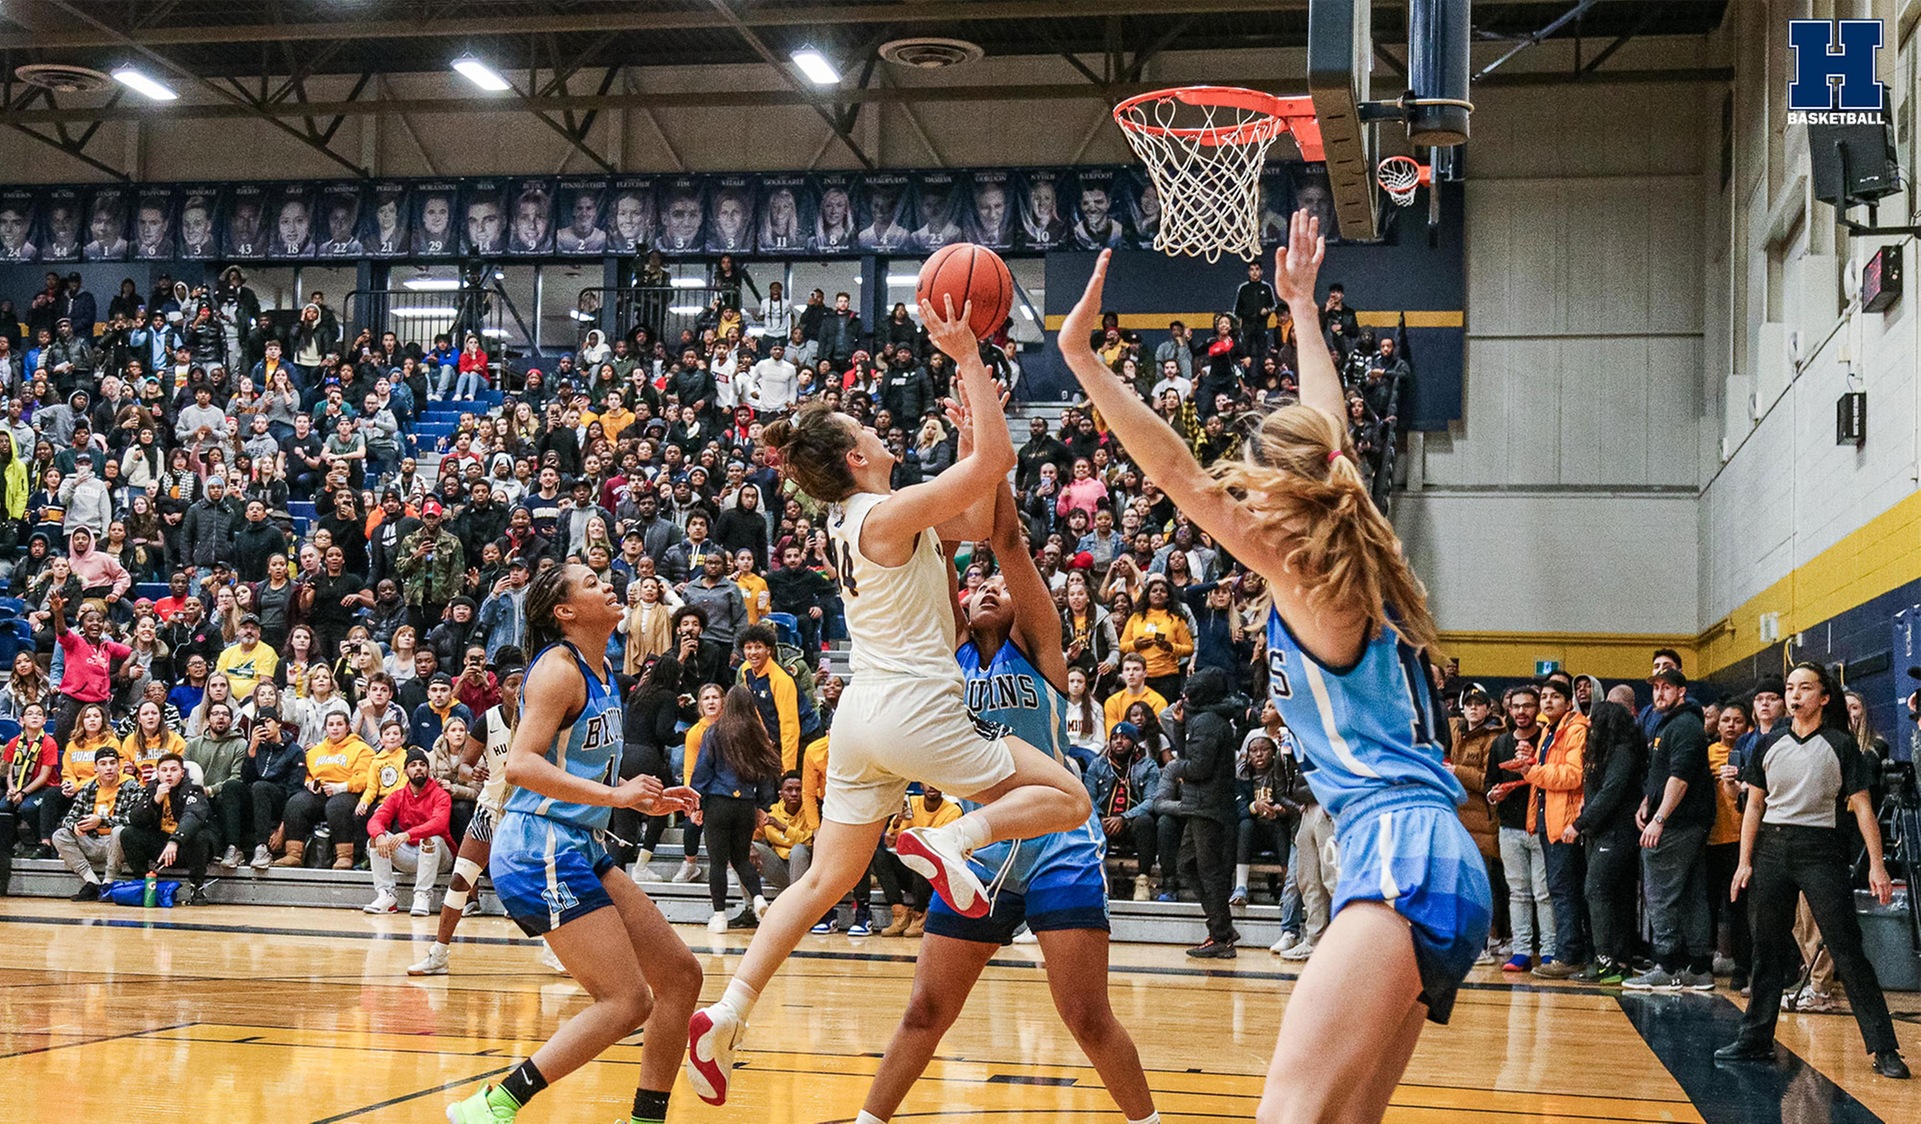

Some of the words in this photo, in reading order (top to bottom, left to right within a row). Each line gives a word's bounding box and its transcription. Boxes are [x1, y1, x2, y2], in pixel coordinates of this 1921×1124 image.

[829, 235, 837, 245] 8
[880, 235, 888, 245] 4
[929, 233, 943, 244] 23
[1036, 231, 1050, 242] 10
[380, 242, 393, 252] 21
[428, 241, 442, 251] 29
[528, 241, 536, 251] 9
[578, 240, 586, 250] 2
[626, 239, 635, 249] 5
[676, 238, 684, 248] 3
[727, 238, 735, 249] 3
[776, 237, 787, 247] 11
[7, 247, 21, 257] 24
[54, 247, 67, 257] 44
[103, 246, 109, 256] 1
[148, 245, 156, 255] 6
[193, 245, 201, 255] 3
[238, 244, 252, 254] 43
[286, 243, 299, 254] 18
[333, 243, 347, 253] 22
[967, 674, 1040, 712] UINS
[493, 744, 508, 757] HU
[540, 881, 580, 914] 11
